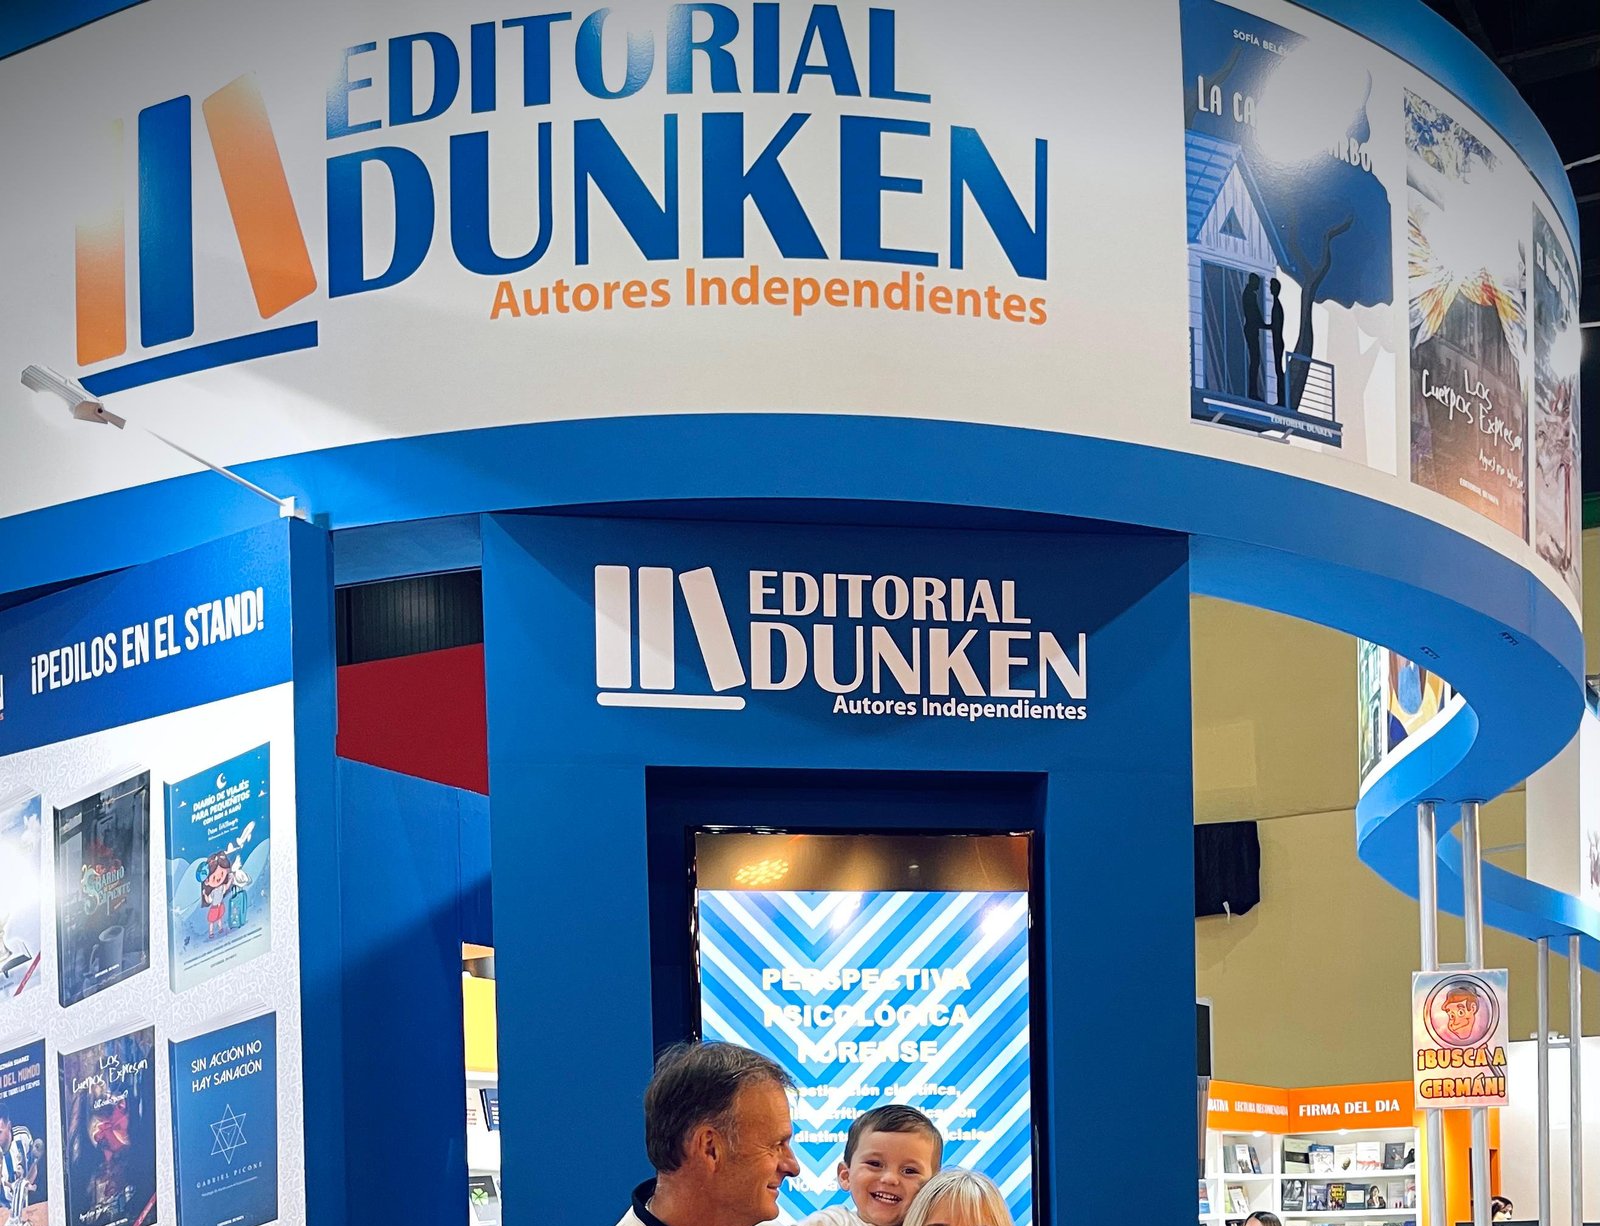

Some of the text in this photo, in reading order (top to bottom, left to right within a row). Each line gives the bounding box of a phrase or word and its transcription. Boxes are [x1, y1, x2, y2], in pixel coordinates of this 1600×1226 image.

[1233, 29, 1290, 56] SOFÍA BELÉ
[326, 2, 931, 140] EDITORIAL
[1197, 75, 1257, 127] LA CA
[326, 112, 1047, 298] DUNKEN
[490, 265, 1048, 326] Autores Independientes
[1464, 368, 1493, 411] Los
[1421, 368, 1523, 452] Cuerpos Expresa
[749, 569, 1031, 625] EDITORIAL
[31, 586, 265, 695] ¡PEDILOS EN EL STAND!
[749, 620, 1087, 700] DUNKEN
[832, 695, 1087, 722] Autores Independientes
[216, 790, 226, 802] DE
[191, 809, 209, 824] PARA
[762, 968, 971, 991] PERSPECTIVA
[763, 1000, 970, 1027] PSICOLÓGICA
[99, 1054, 120, 1070] Los
[191, 1039, 262, 1073] SIN ACCIÓN NO
[1417, 1046, 1507, 1071] ¡BUSCA A
[72, 1058, 149, 1094] Cuerpos Expresan
[192, 1058, 262, 1093] HAY SANACIÓN
[1420, 1072, 1506, 1099] GERMÁN!
[1299, 1098, 1400, 1117] FIRMA DEL DIA
[196, 1173, 230, 1189] GABRIEL
[233, 1161, 263, 1178] PICONE
